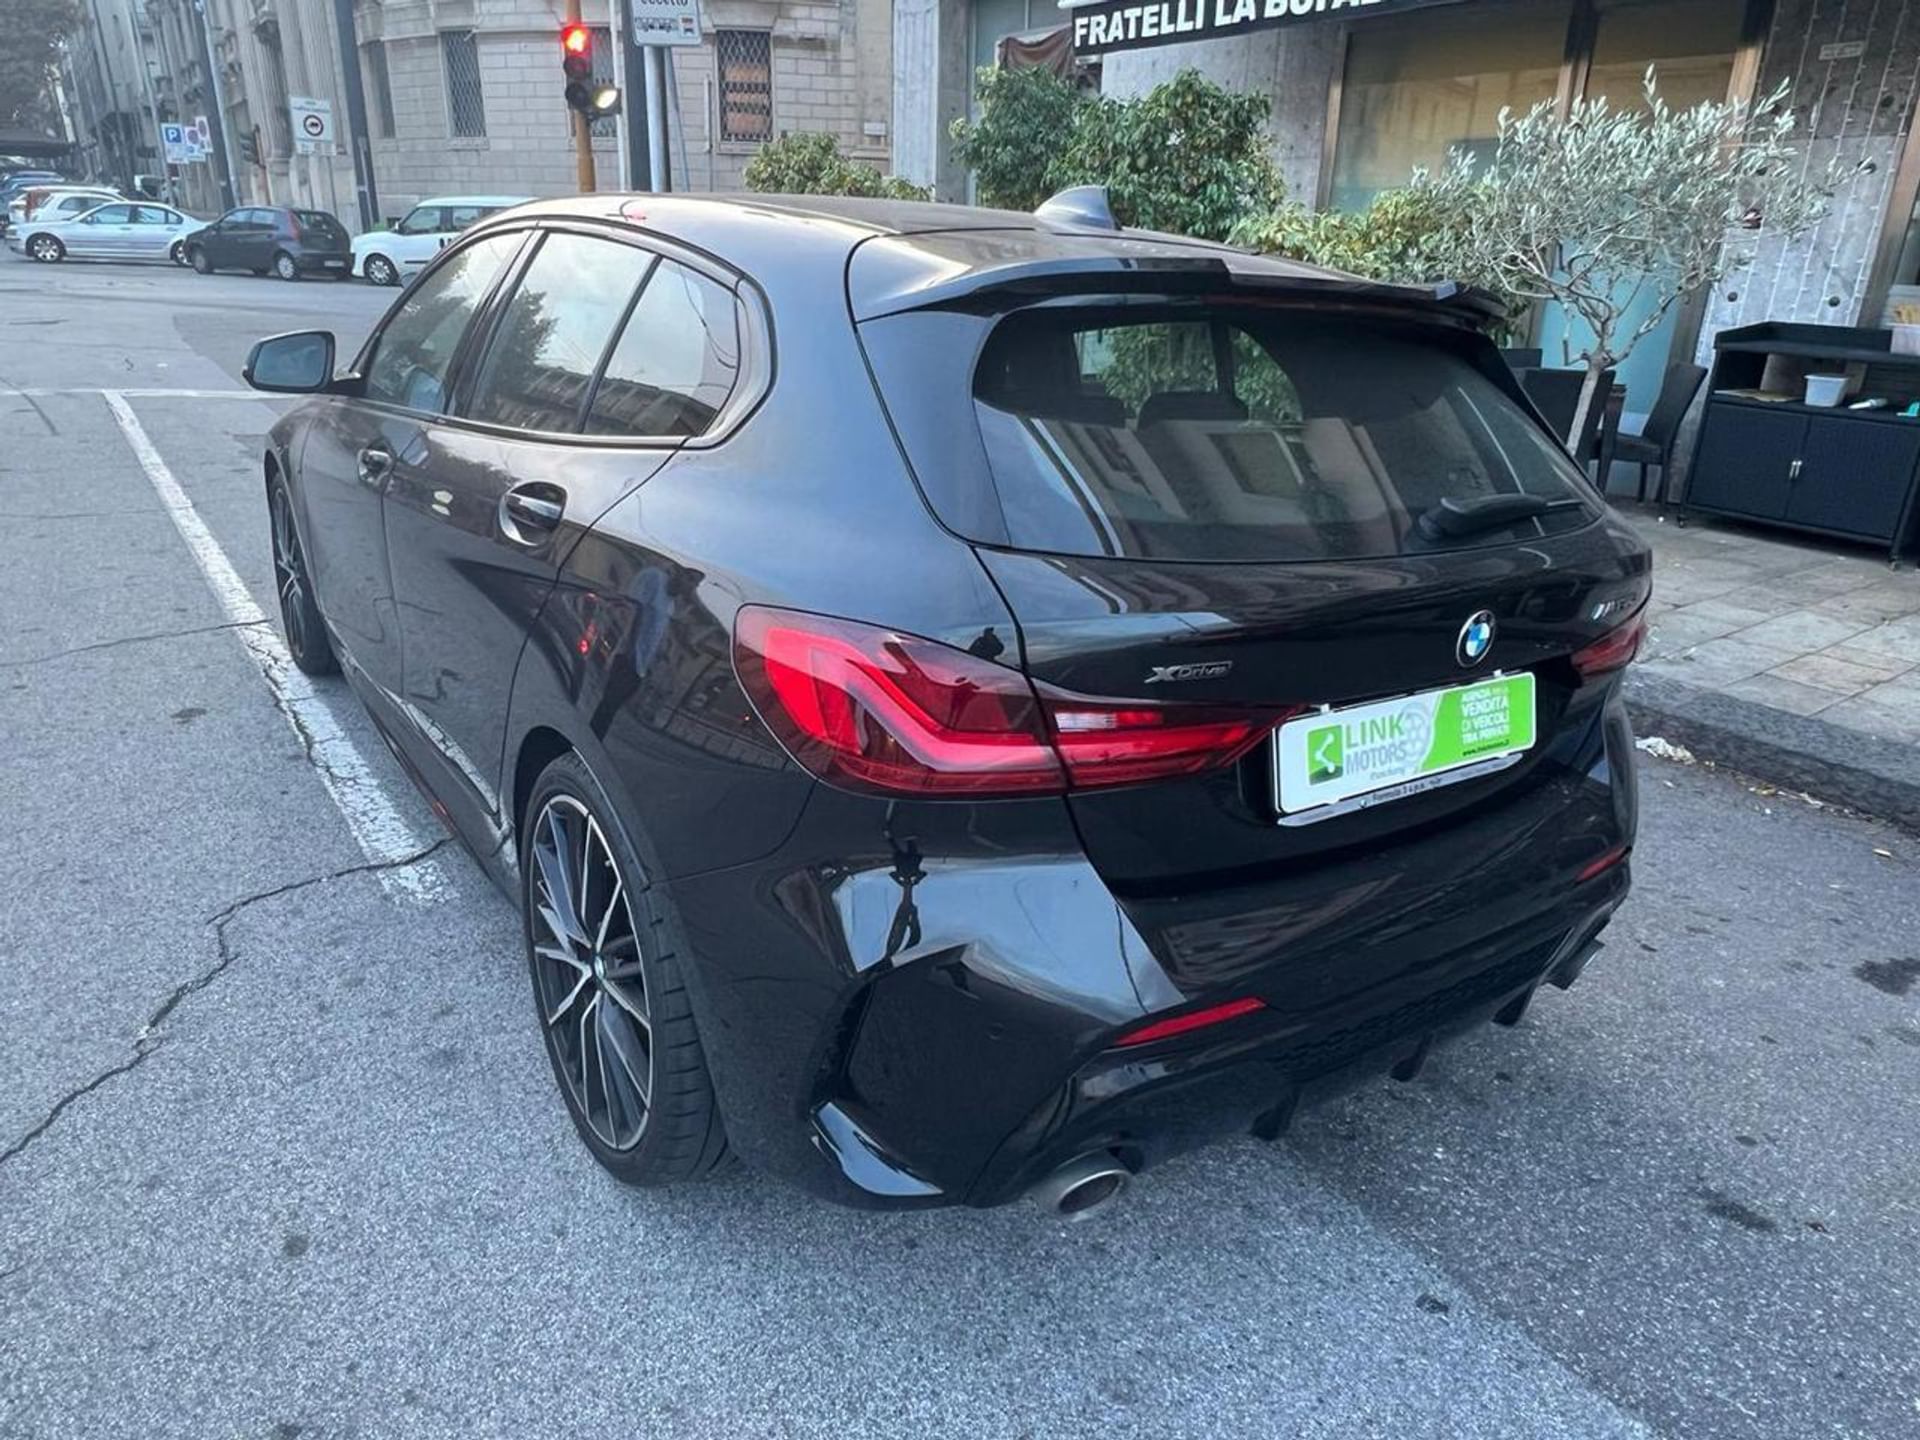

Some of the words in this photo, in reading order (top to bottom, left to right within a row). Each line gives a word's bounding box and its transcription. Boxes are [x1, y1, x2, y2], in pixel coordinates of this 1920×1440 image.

[1074, 0, 1205, 48] FRATELLI
[1214, 0, 1257, 27] LA
[1462, 695, 1509, 717] VENDITA
[1345, 711, 1405, 749] LINK
[1345, 740, 1407, 776] MOTORS
